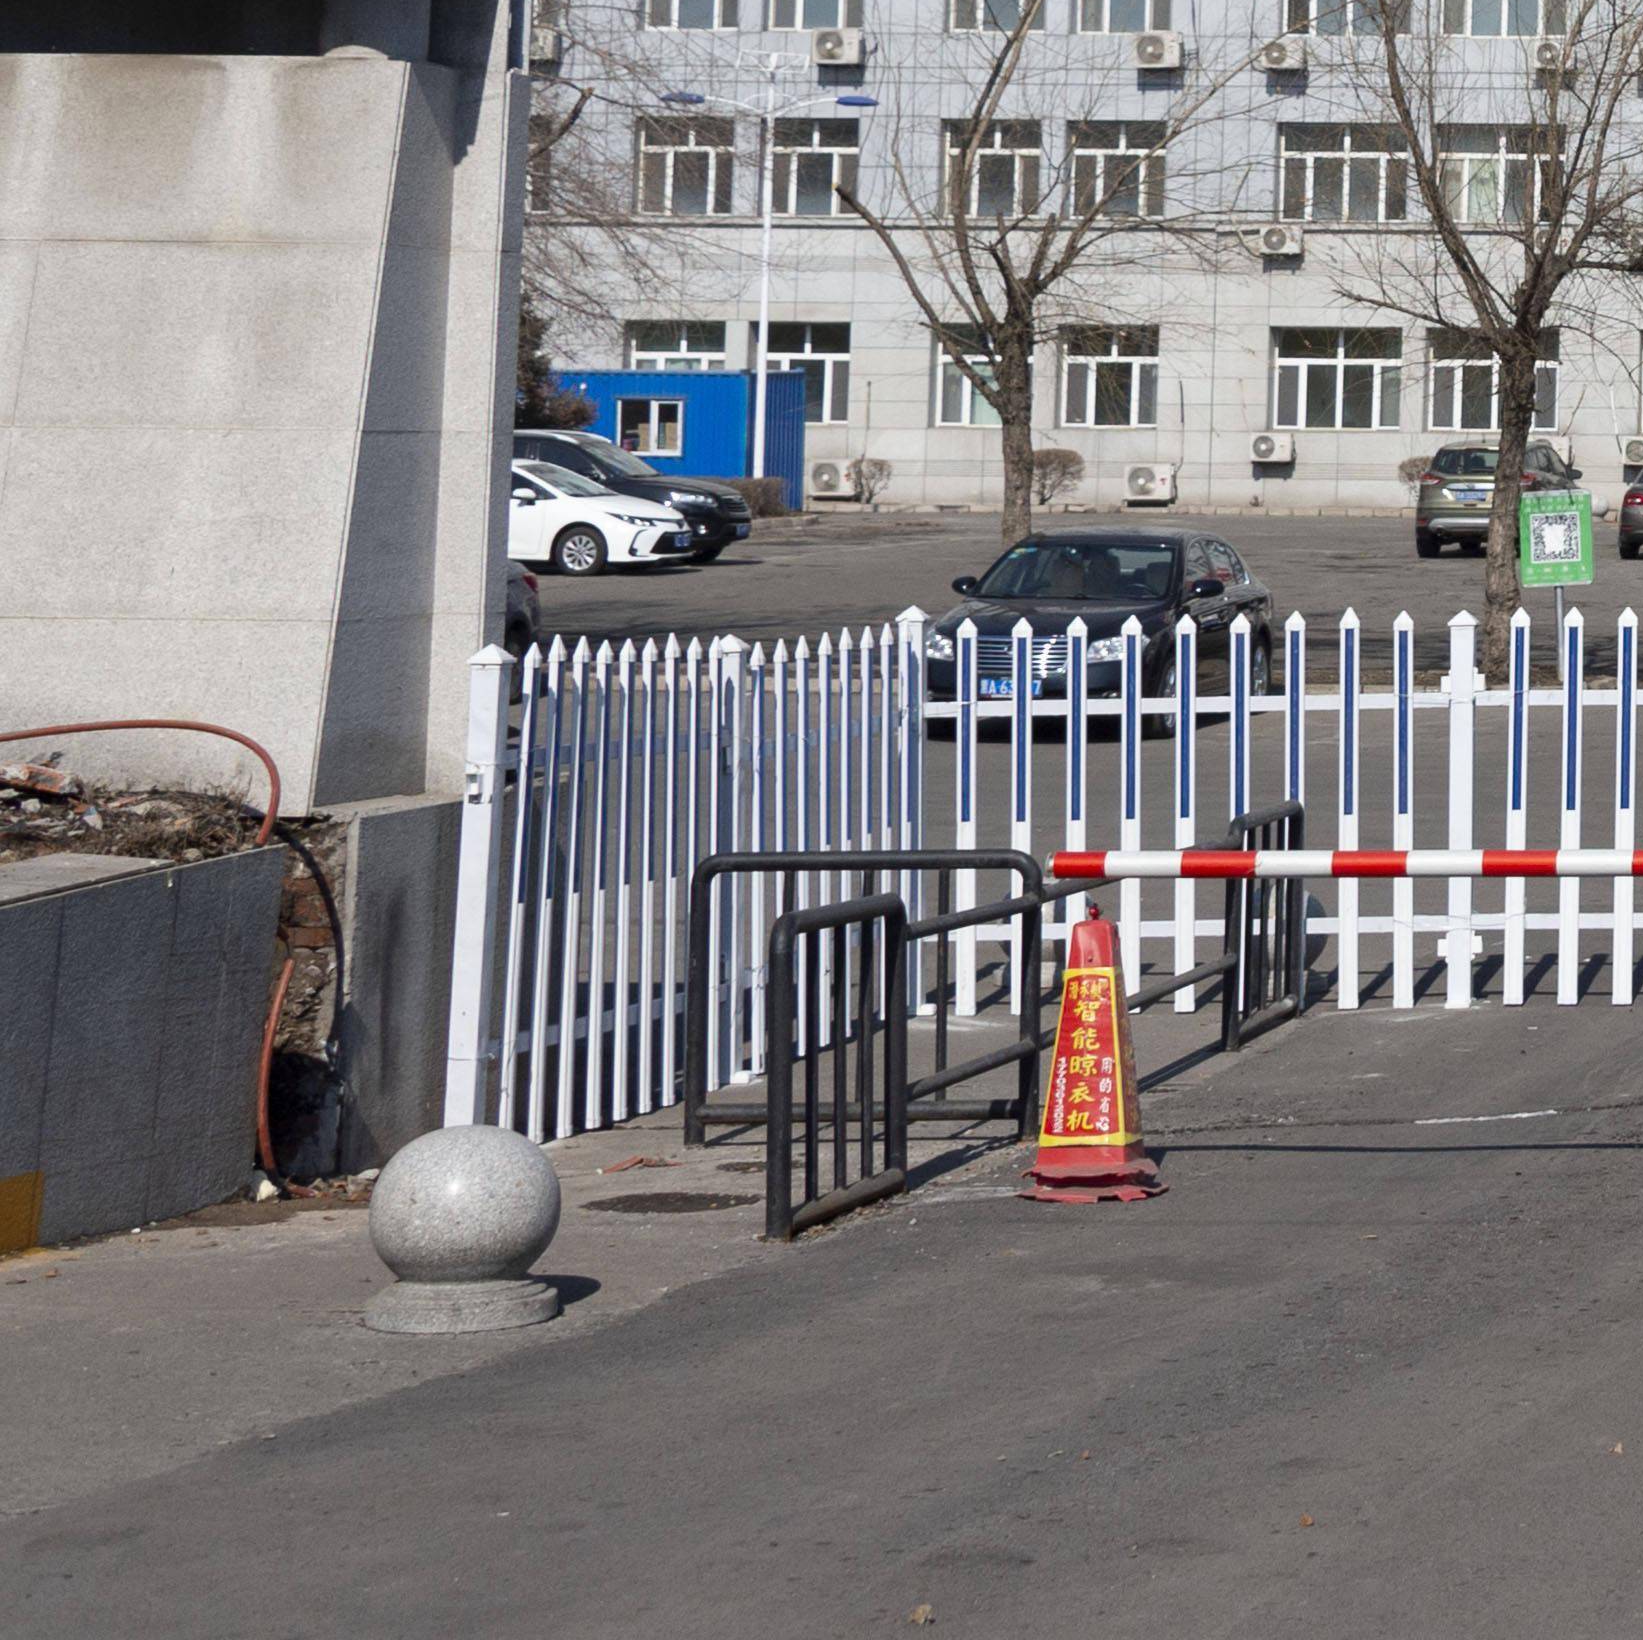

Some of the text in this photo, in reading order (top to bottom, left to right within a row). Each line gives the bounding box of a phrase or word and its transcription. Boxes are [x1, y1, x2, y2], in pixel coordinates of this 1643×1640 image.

[1067, 999, 1101, 1132] 智能晾衣机
